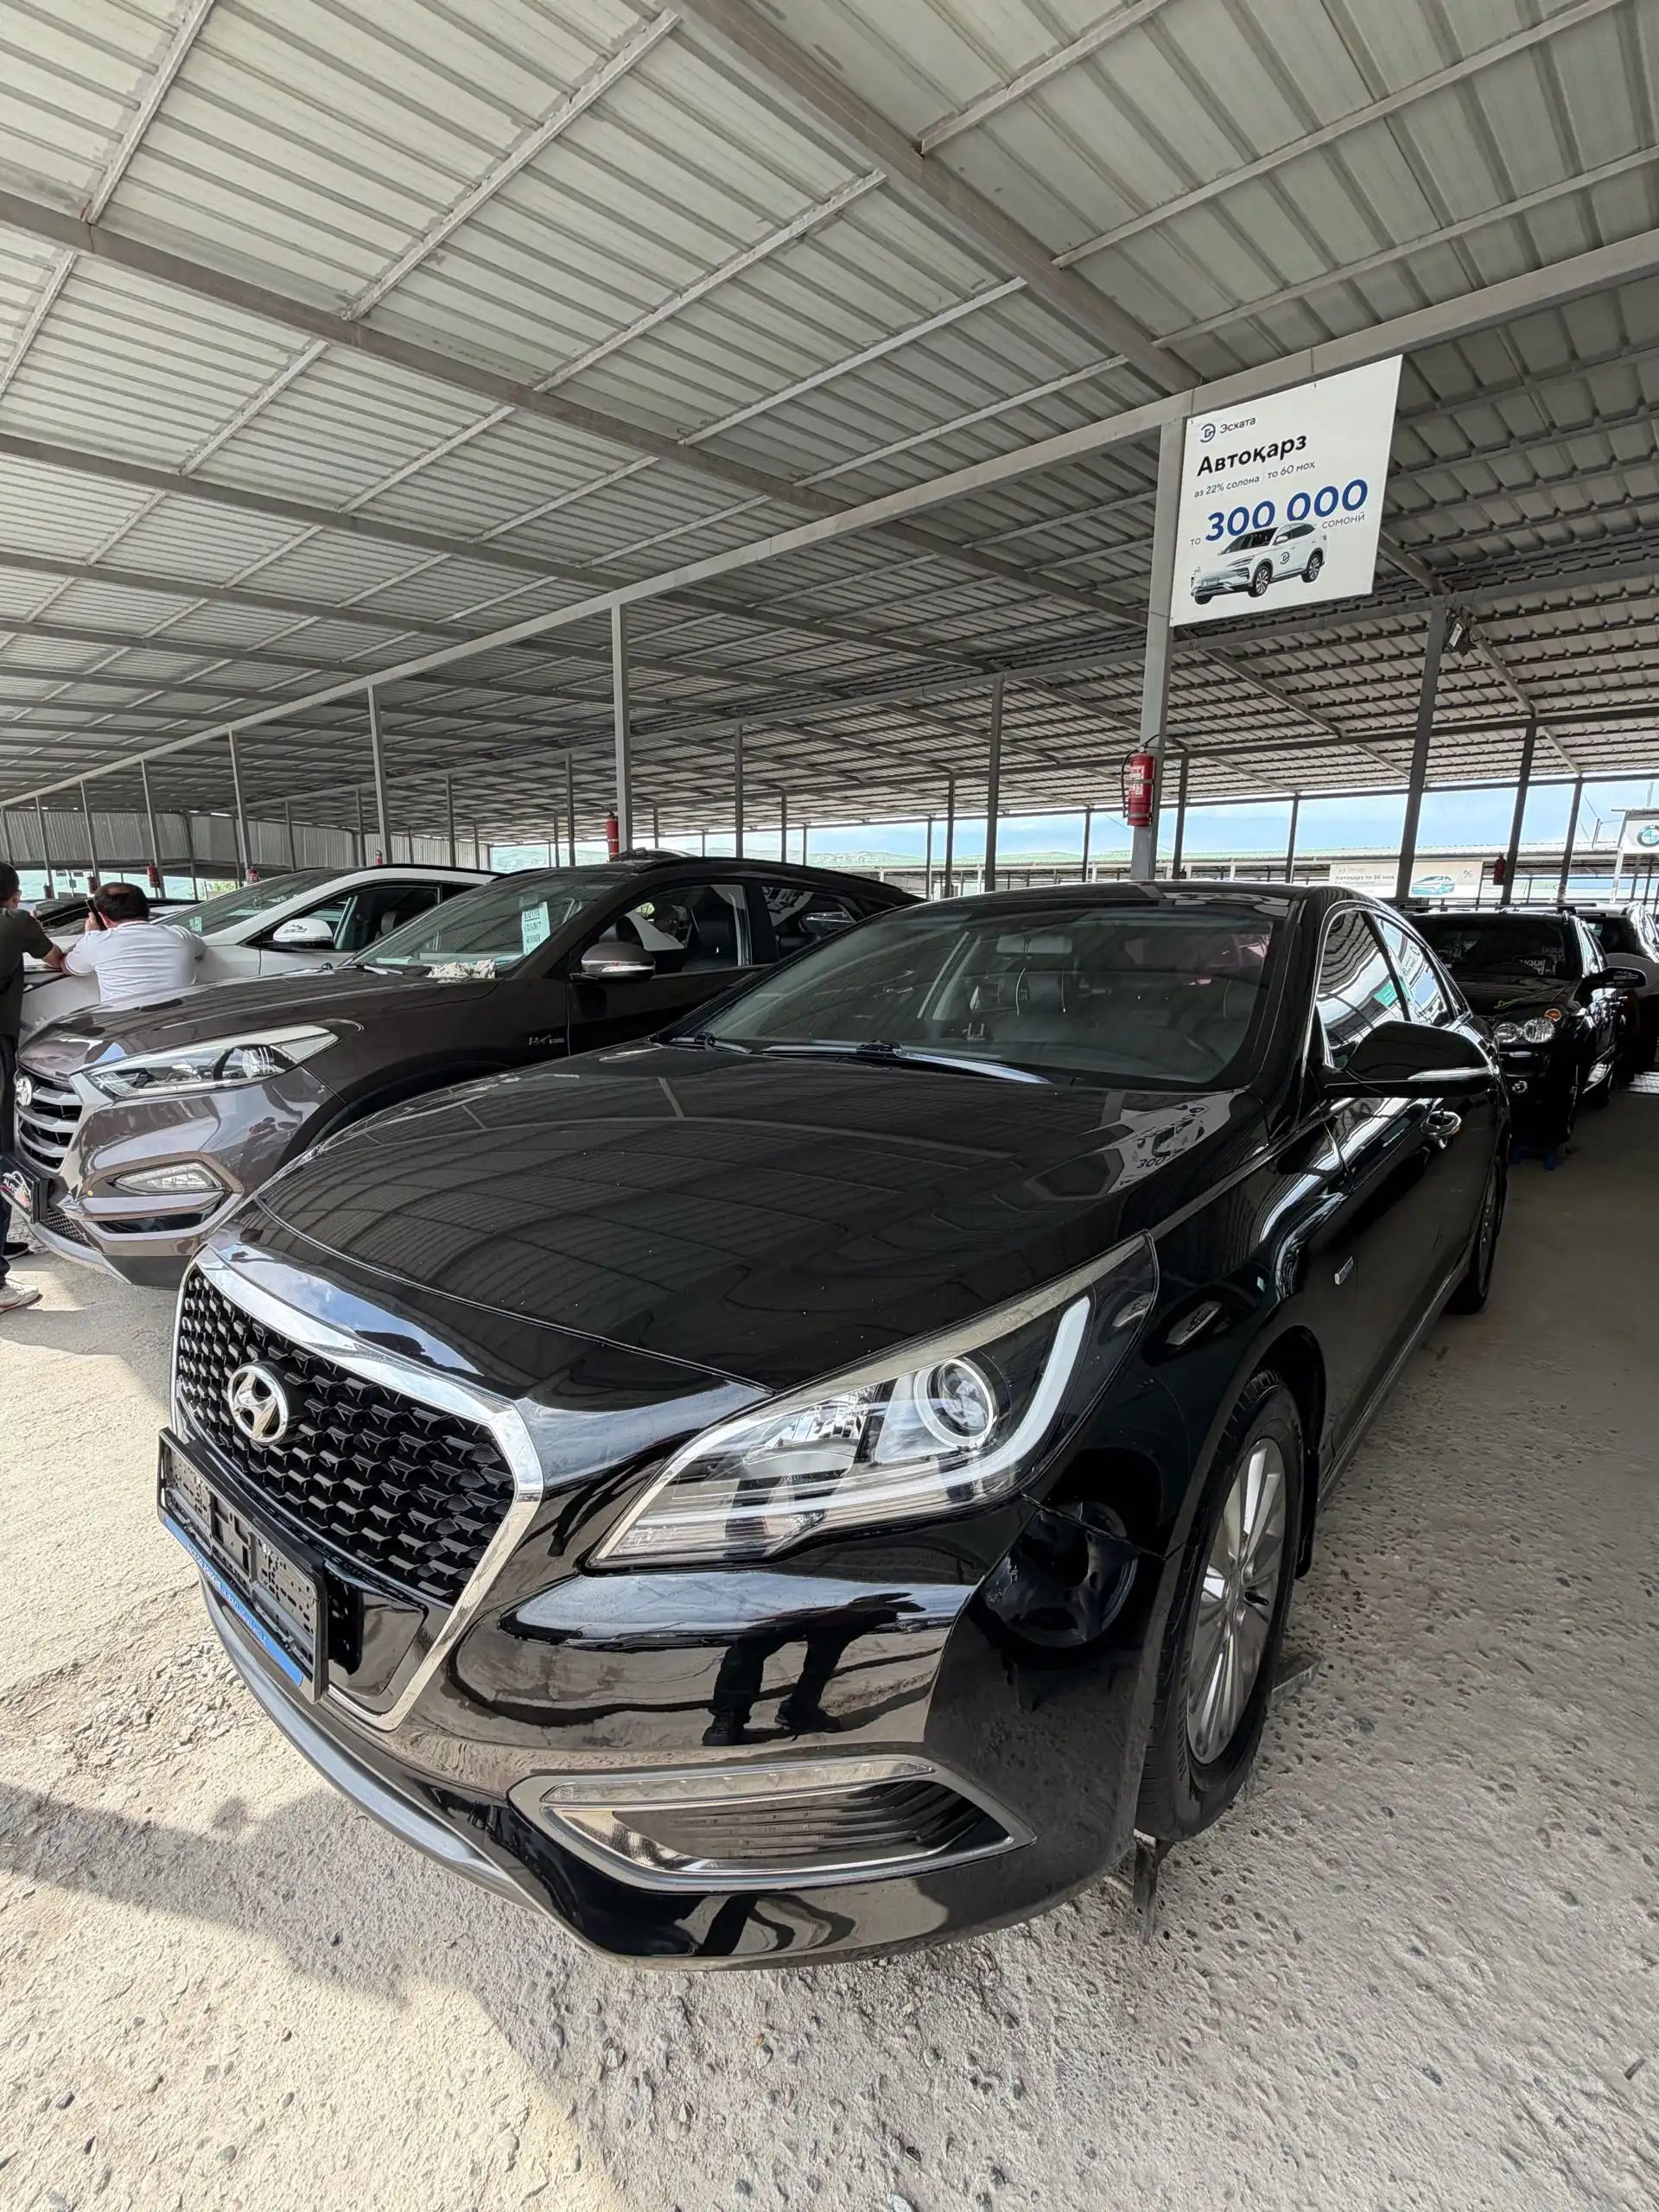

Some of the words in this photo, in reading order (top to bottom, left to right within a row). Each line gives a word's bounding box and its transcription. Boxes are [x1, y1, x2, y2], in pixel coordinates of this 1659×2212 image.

[1219, 416, 1256, 434] Эсхата
[1196, 435, 1307, 477] Автоқарз
[1205, 483, 1224, 495] 22%
[1226, 475, 1260, 491] солона
[1280, 464, 1294, 476] 60
[1190, 537, 1201, 546] то
[1205, 500, 1276, 542] 300
[1287, 479, 1369, 522] 000
